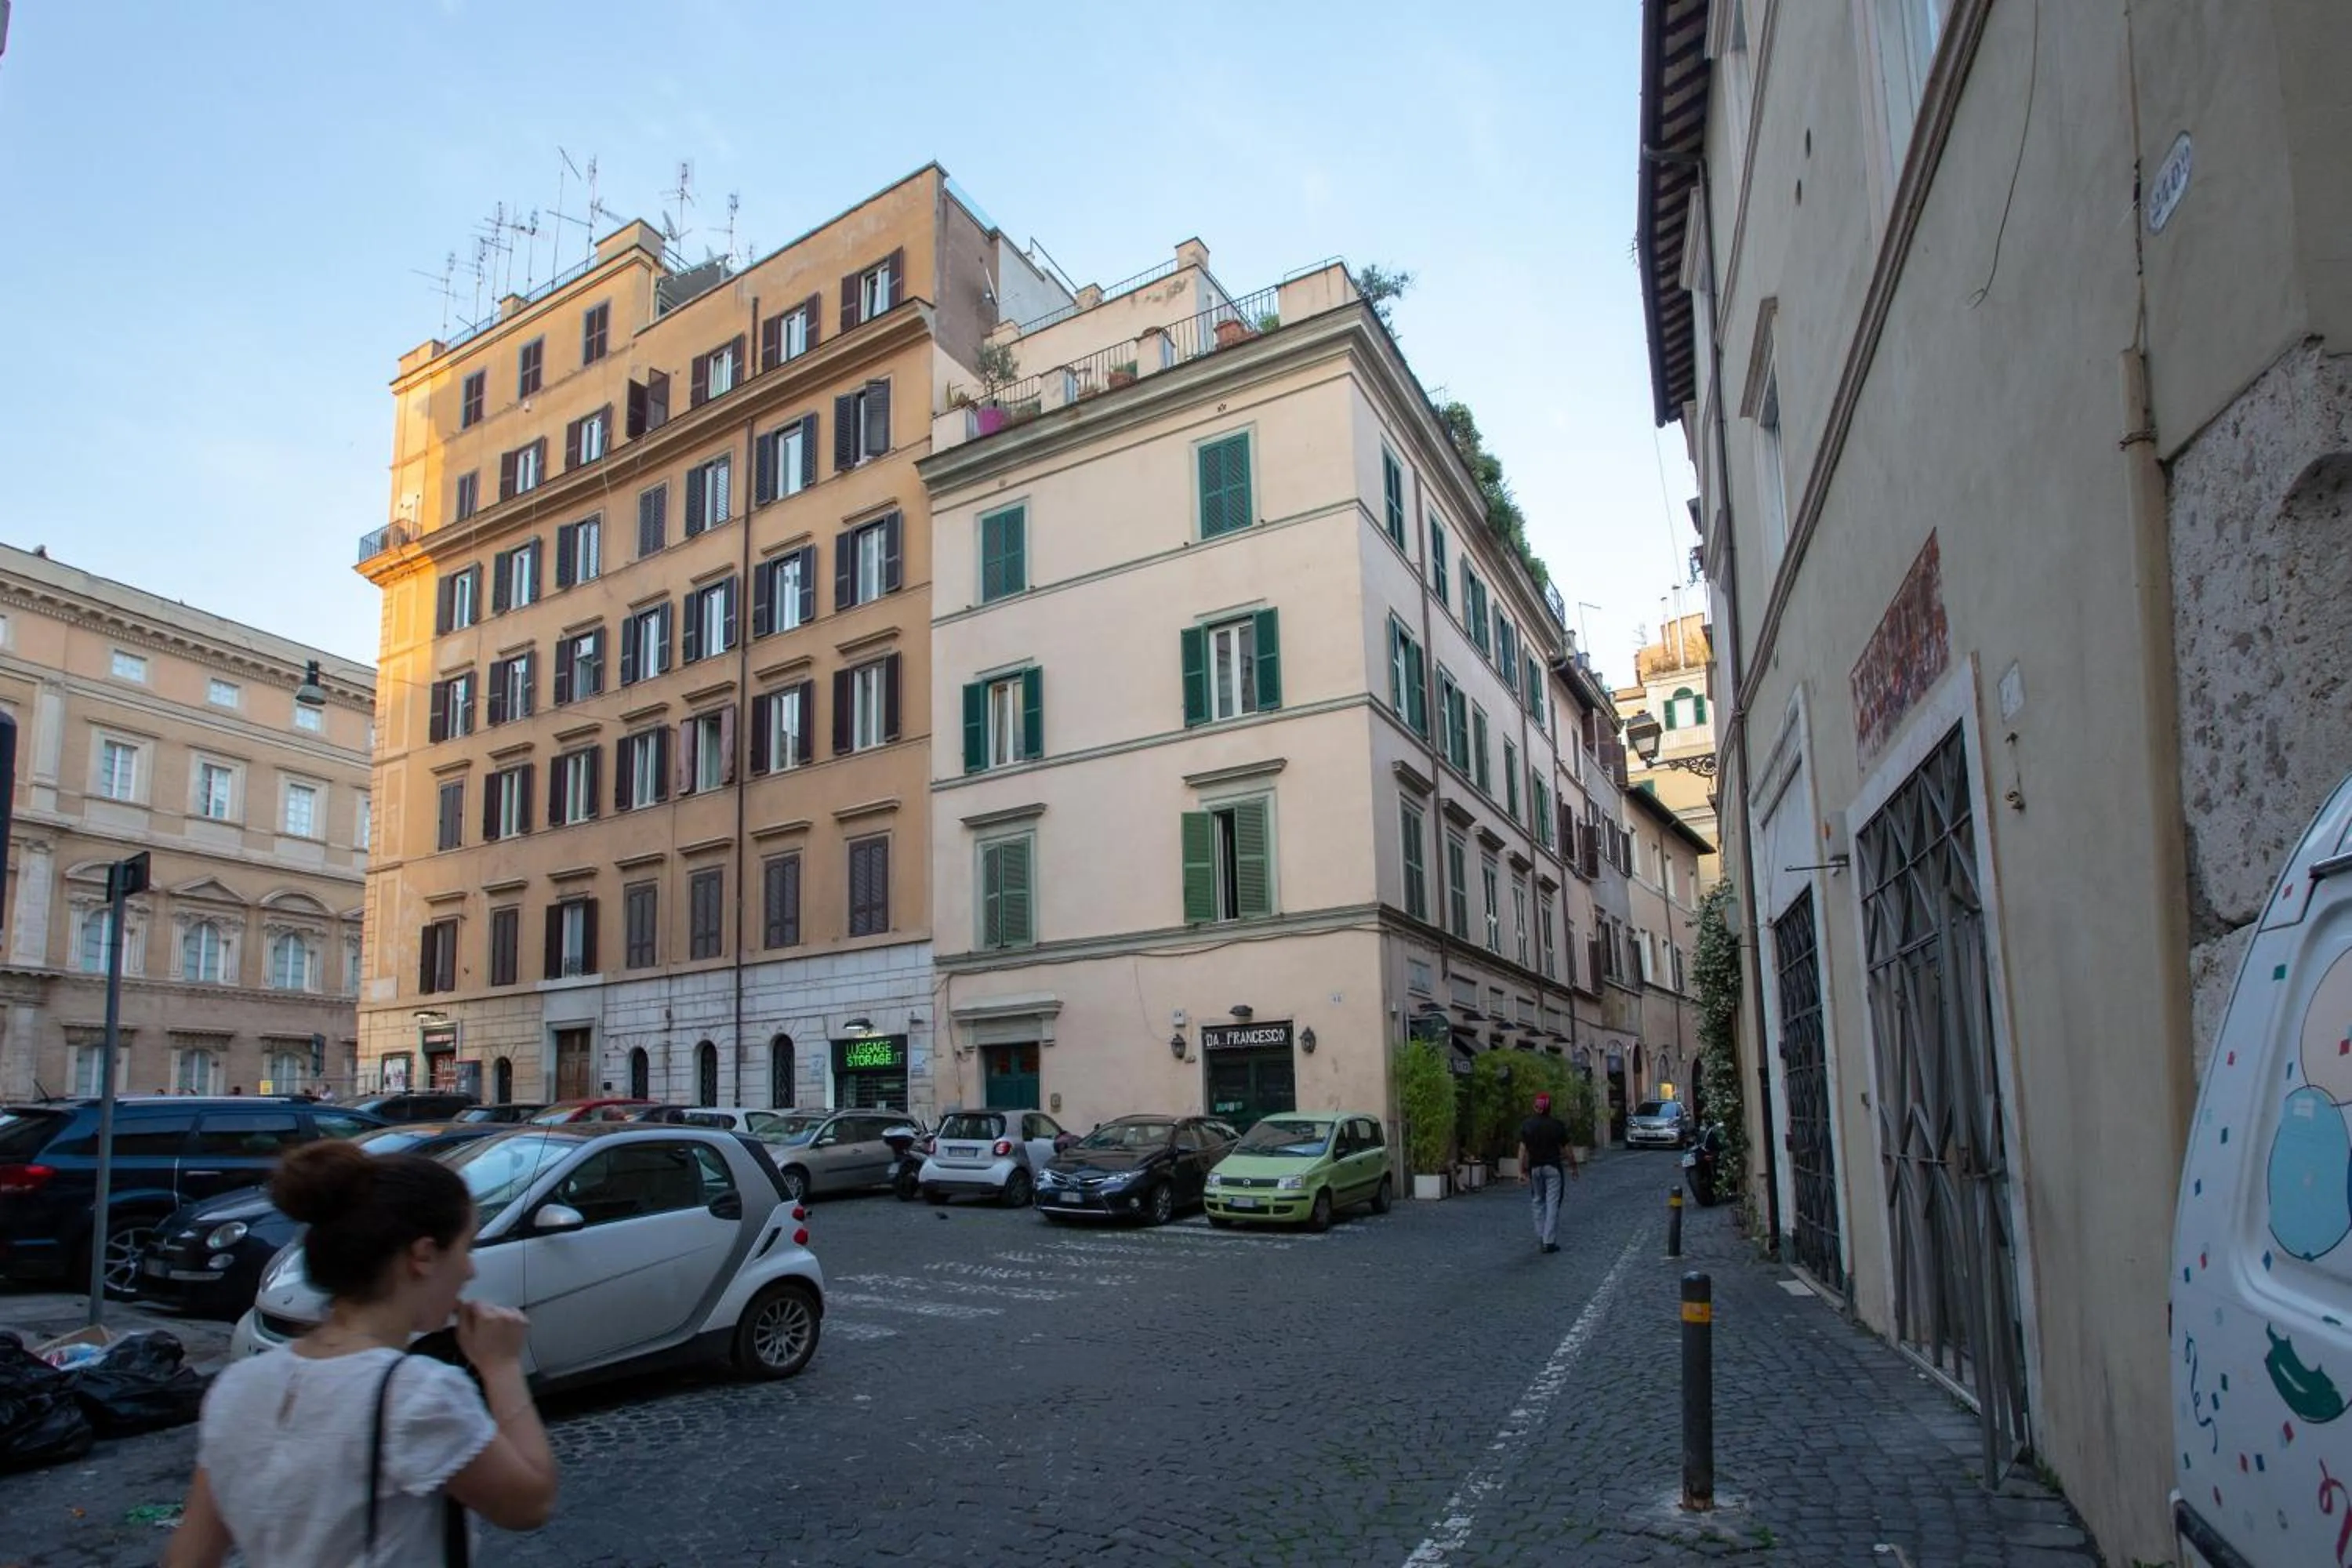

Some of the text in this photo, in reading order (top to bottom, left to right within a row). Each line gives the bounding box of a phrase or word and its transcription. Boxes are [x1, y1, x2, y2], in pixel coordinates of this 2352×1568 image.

[1206, 1029, 1286, 1047] DA FRANCESCO
[847, 1041, 891, 1054] LUGGAGE
